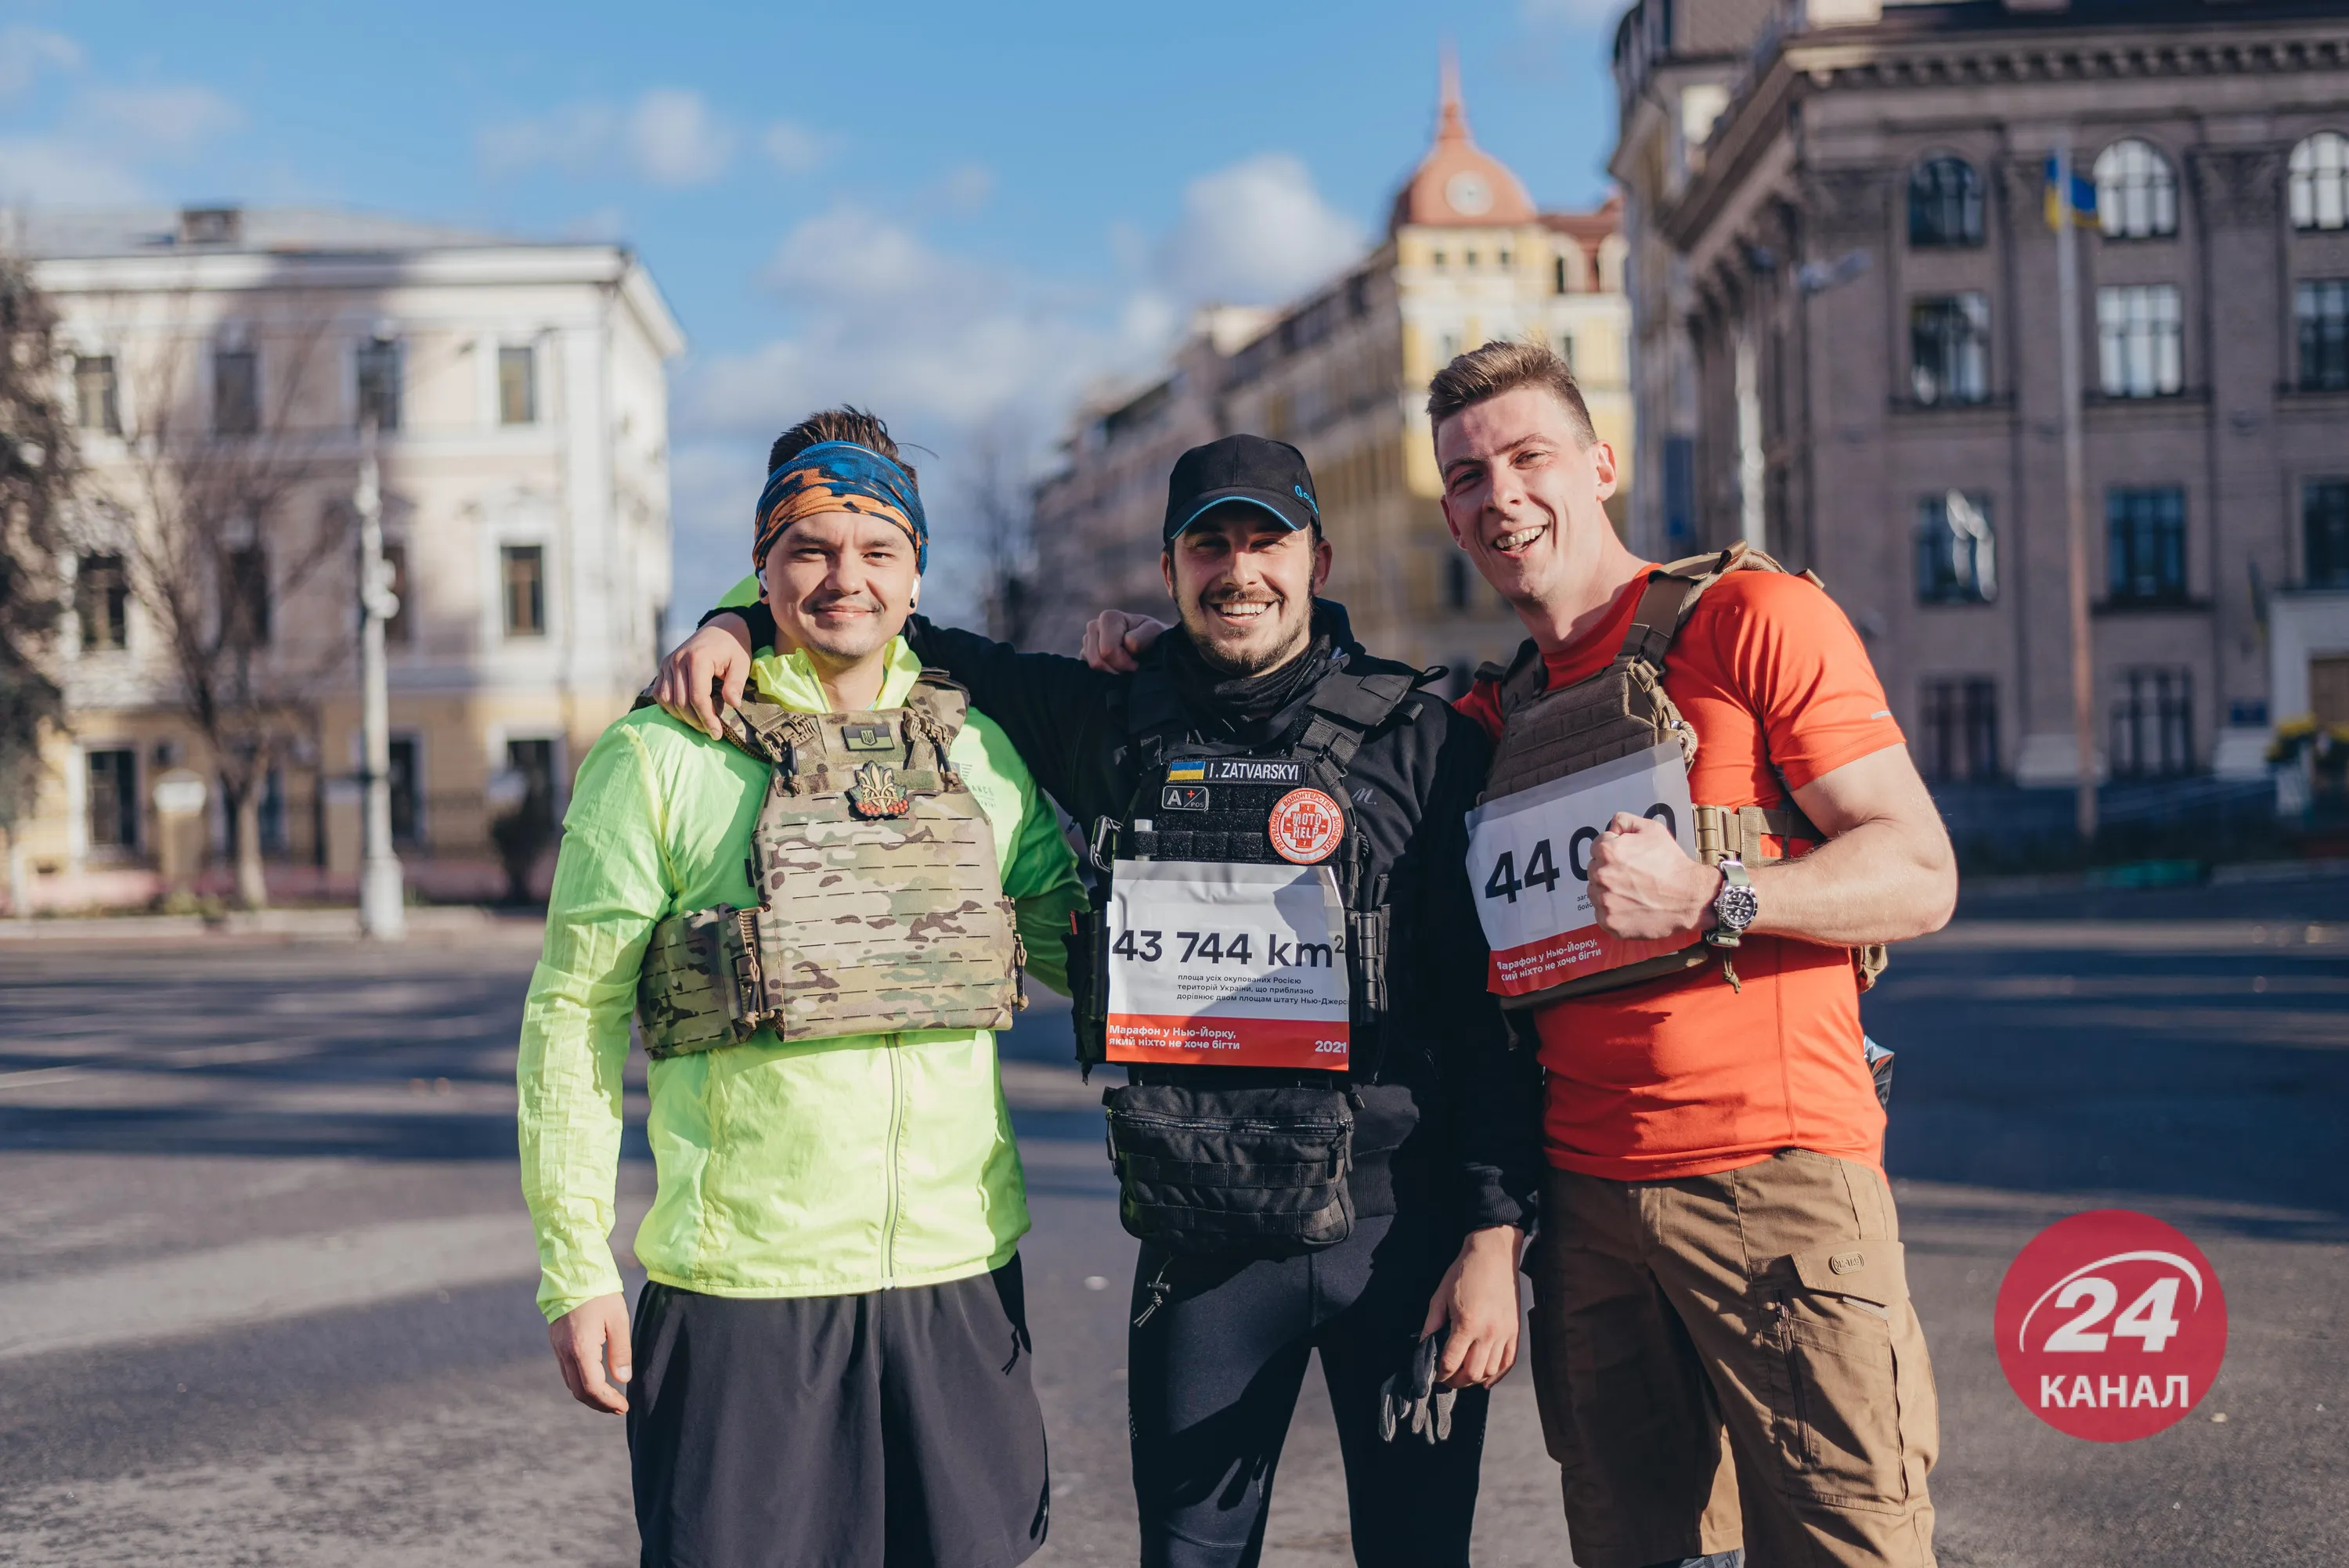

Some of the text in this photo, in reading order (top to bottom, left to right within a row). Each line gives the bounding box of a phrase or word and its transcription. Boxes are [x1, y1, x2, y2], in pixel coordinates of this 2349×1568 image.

[1221, 762, 1299, 780] ZATVARSKYI
[1167, 790, 1182, 806] A
[1292, 813, 1322, 825] MOTO
[1293, 826, 1319, 838] HELP
[1485, 838, 1560, 904] 44
[1113, 929, 1162, 962] 43
[1177, 932, 1252, 964] 744
[1539, 953, 1544, 963] у
[1546, 939, 1597, 960] Нью-Йорку,
[1519, 965, 1543, 978] ніхто
[1545, 963, 1556, 971] не
[1557, 955, 1577, 968] хоче
[1578, 948, 1601, 961] бігти
[1178, 983, 1218, 992] територій
[1220, 984, 1254, 993] України,
[1269, 986, 1314, 995] приблизно
[1109, 1025, 1236, 1040] Марафон у Нью-Йорку,
[1109, 1036, 1135, 1046] який
[1138, 1037, 1165, 1047] ніхто
[1211, 1040, 1240, 1050] бігти
[1315, 1040, 1348, 1054] 2021
